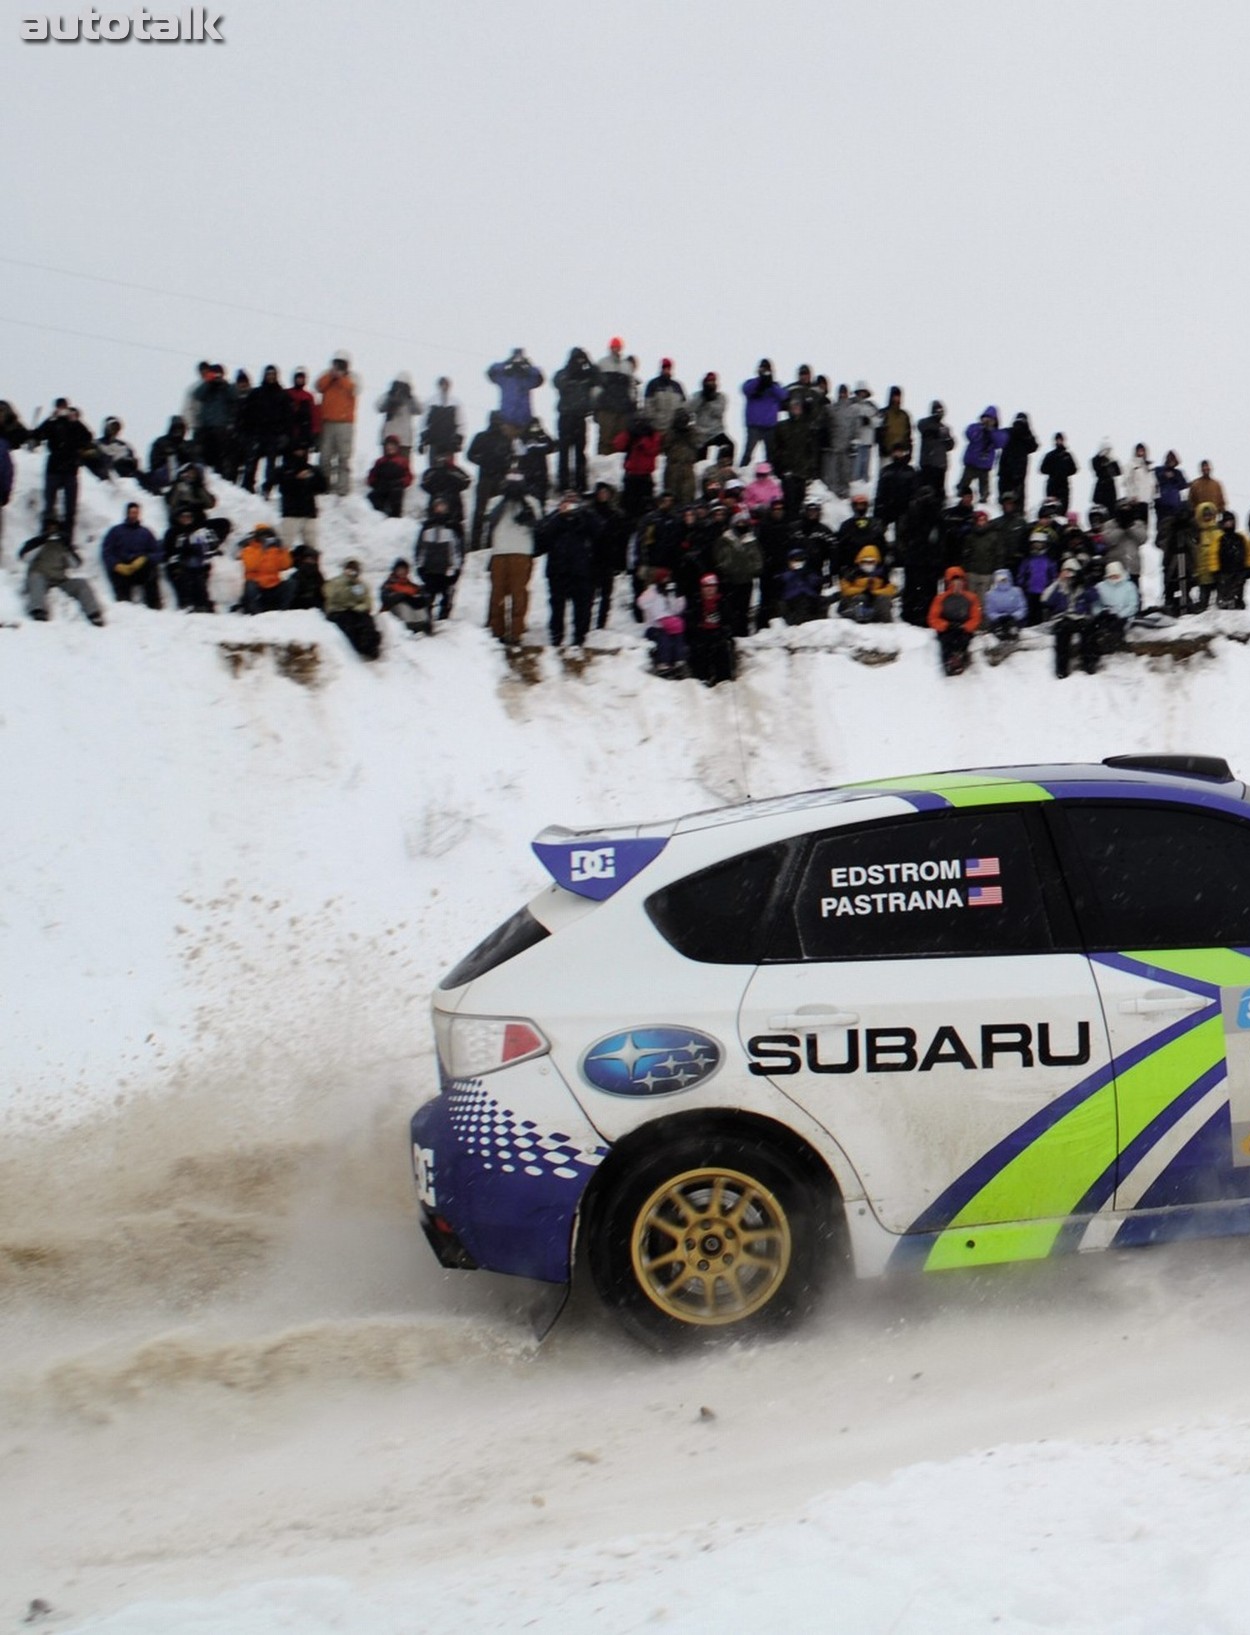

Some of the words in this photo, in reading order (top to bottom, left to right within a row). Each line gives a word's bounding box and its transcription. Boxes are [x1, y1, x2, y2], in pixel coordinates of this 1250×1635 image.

[570, 847, 616, 882] DC
[831, 859, 961, 888] EDSTROM
[821, 888, 964, 918] PASTRANA
[747, 1021, 1091, 1076] SUBARU
